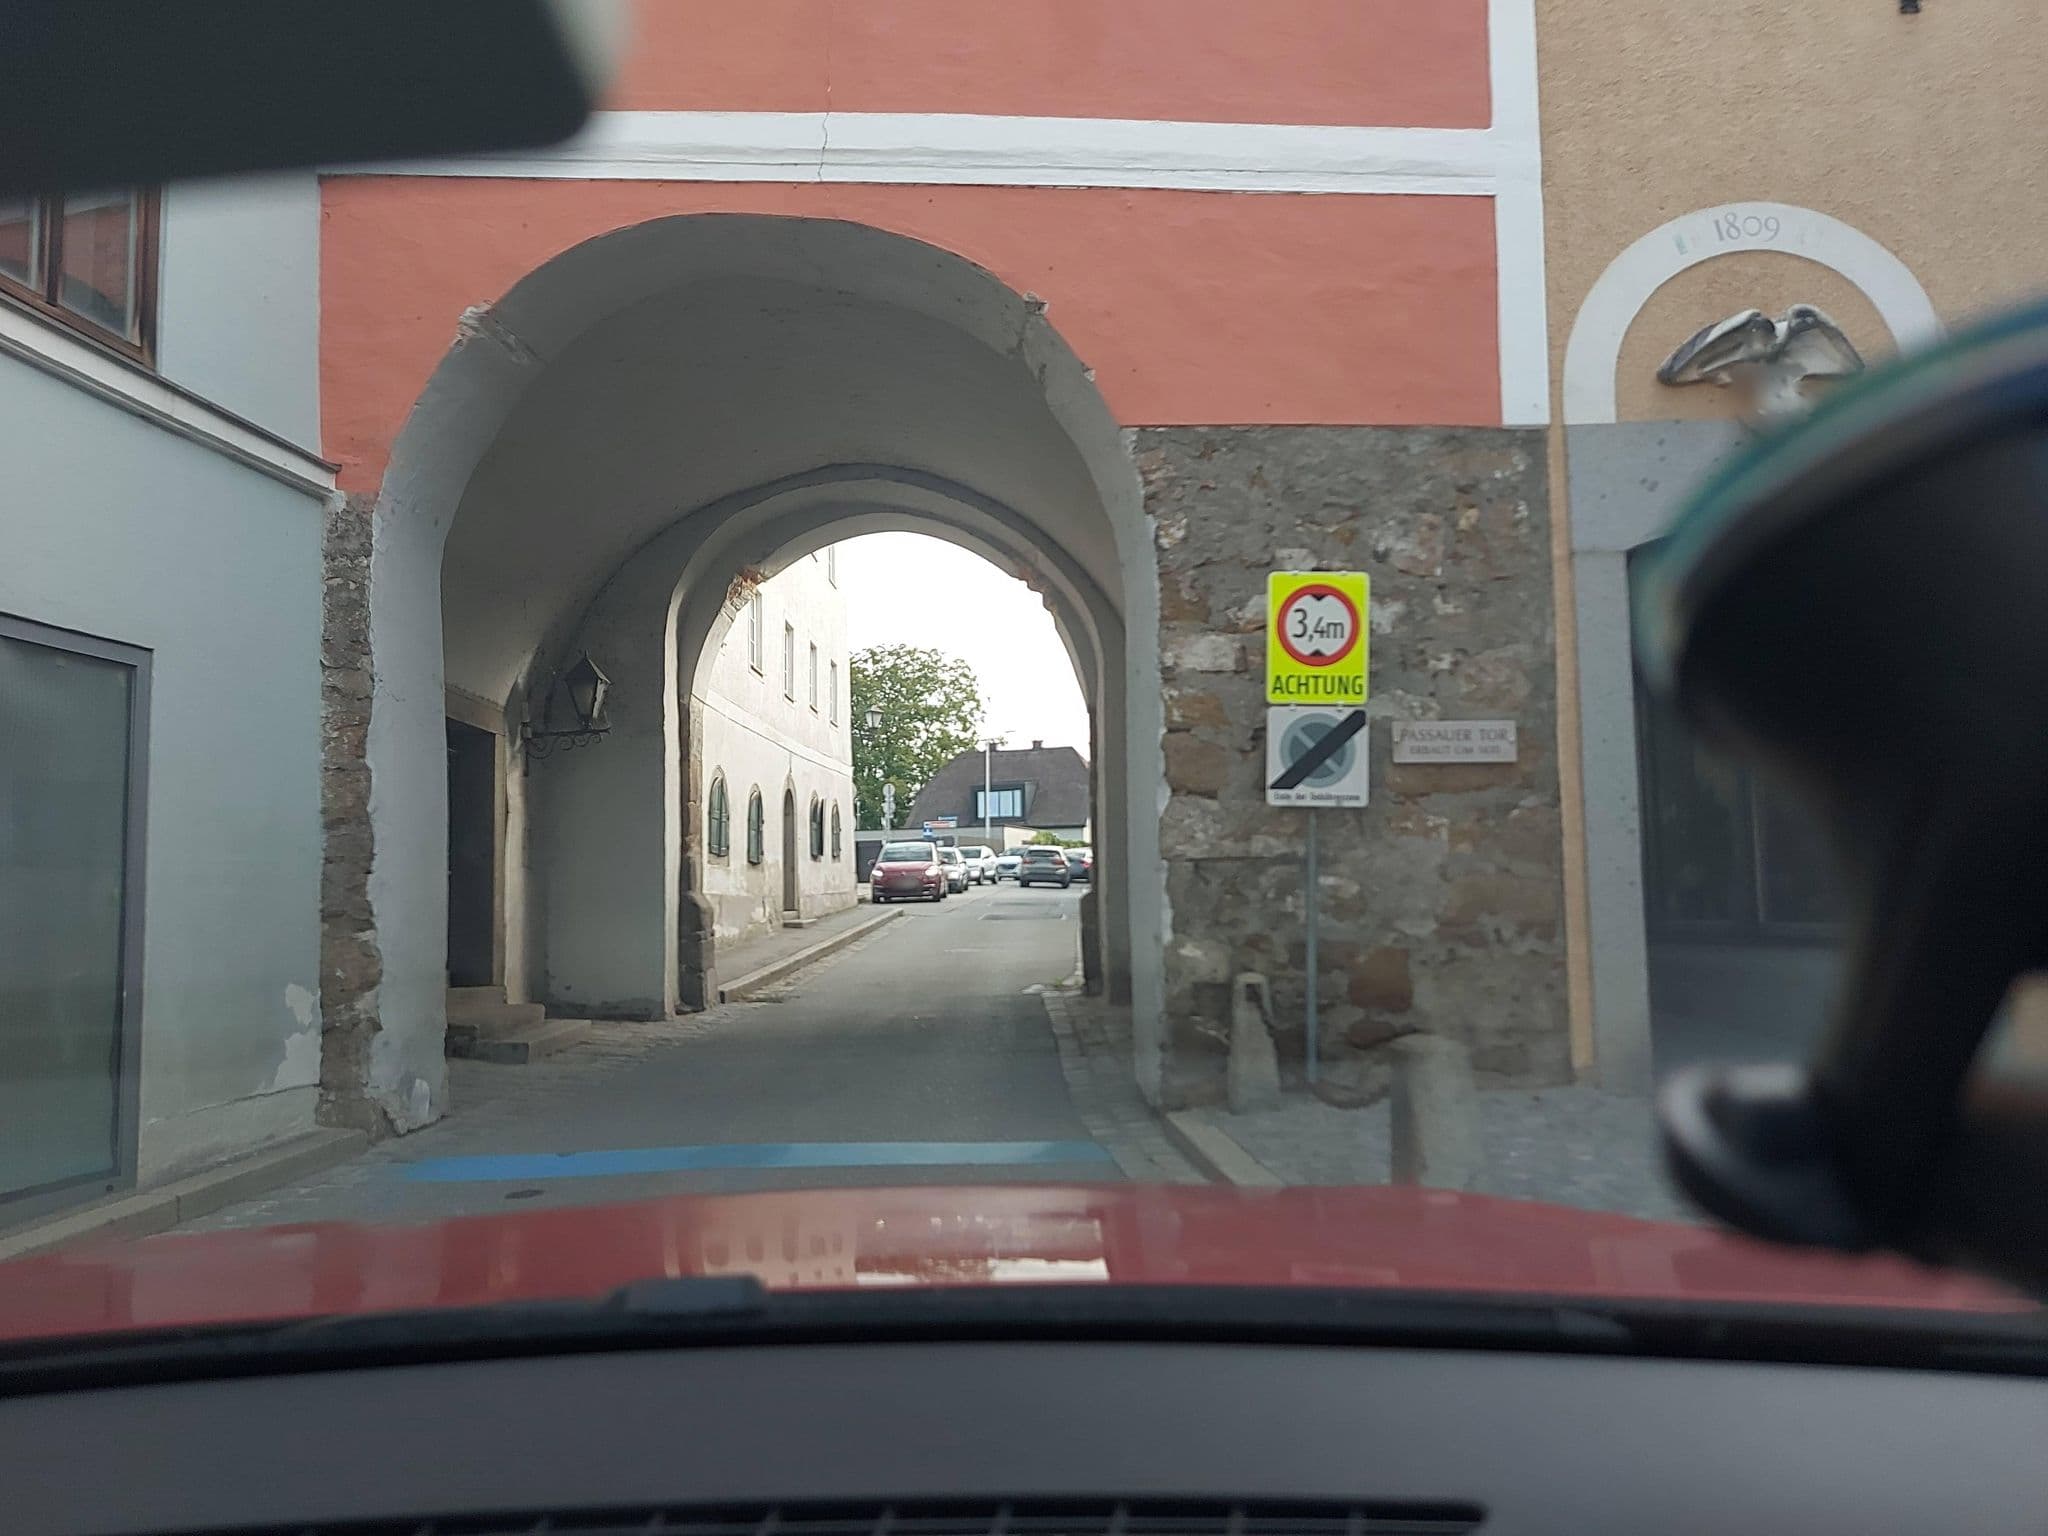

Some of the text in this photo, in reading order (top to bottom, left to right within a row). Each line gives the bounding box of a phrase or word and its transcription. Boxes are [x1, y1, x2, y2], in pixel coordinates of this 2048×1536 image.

[1713, 212, 1781, 243] 1809
[1292, 608, 1345, 643] 3,4m
[1272, 674, 1364, 695] ACHTUNG
[1400, 727, 1508, 741] PASSAUER TOR
